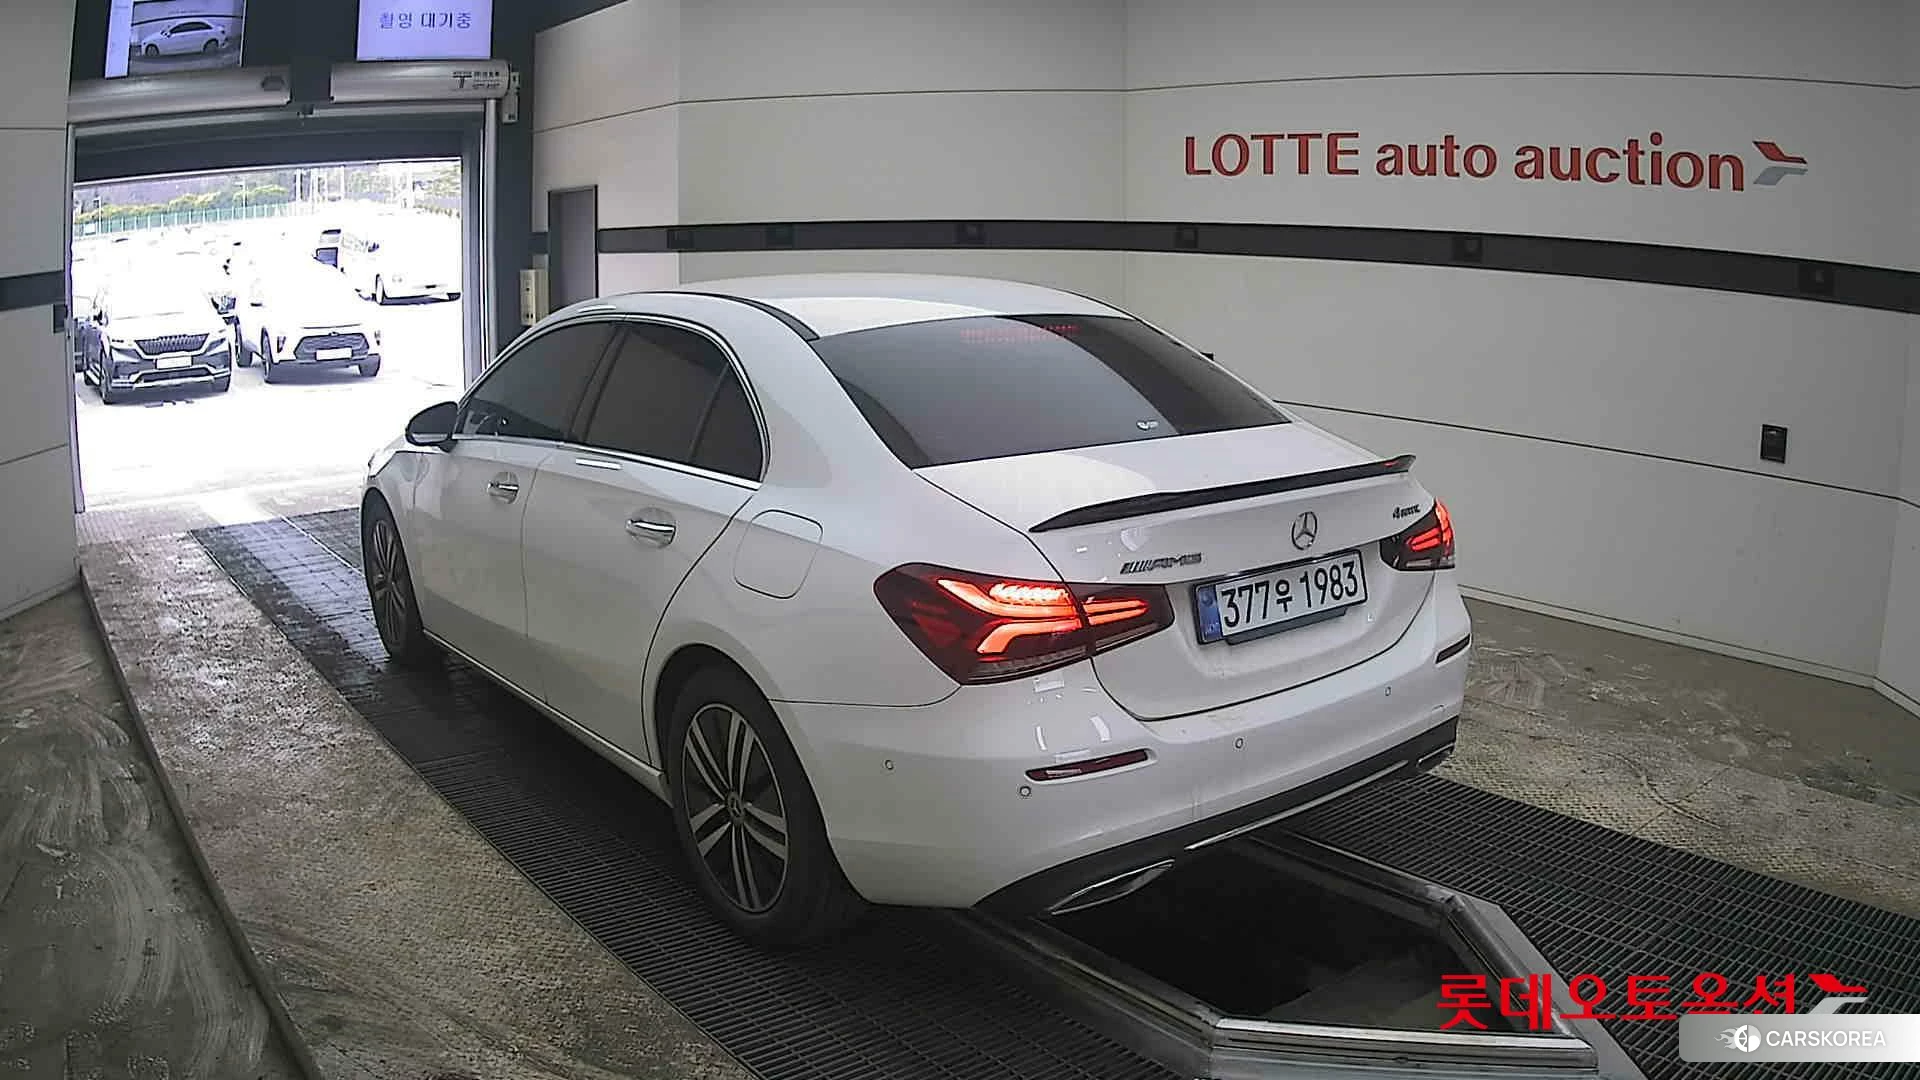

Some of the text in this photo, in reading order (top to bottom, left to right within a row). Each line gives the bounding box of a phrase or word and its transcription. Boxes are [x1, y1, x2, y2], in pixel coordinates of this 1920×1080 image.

[421, 12, 471, 29] 대기중
[1185, 132, 1745, 191] LOTTE auto auction
[1221, 561, 1358, 627] 377우 1983
